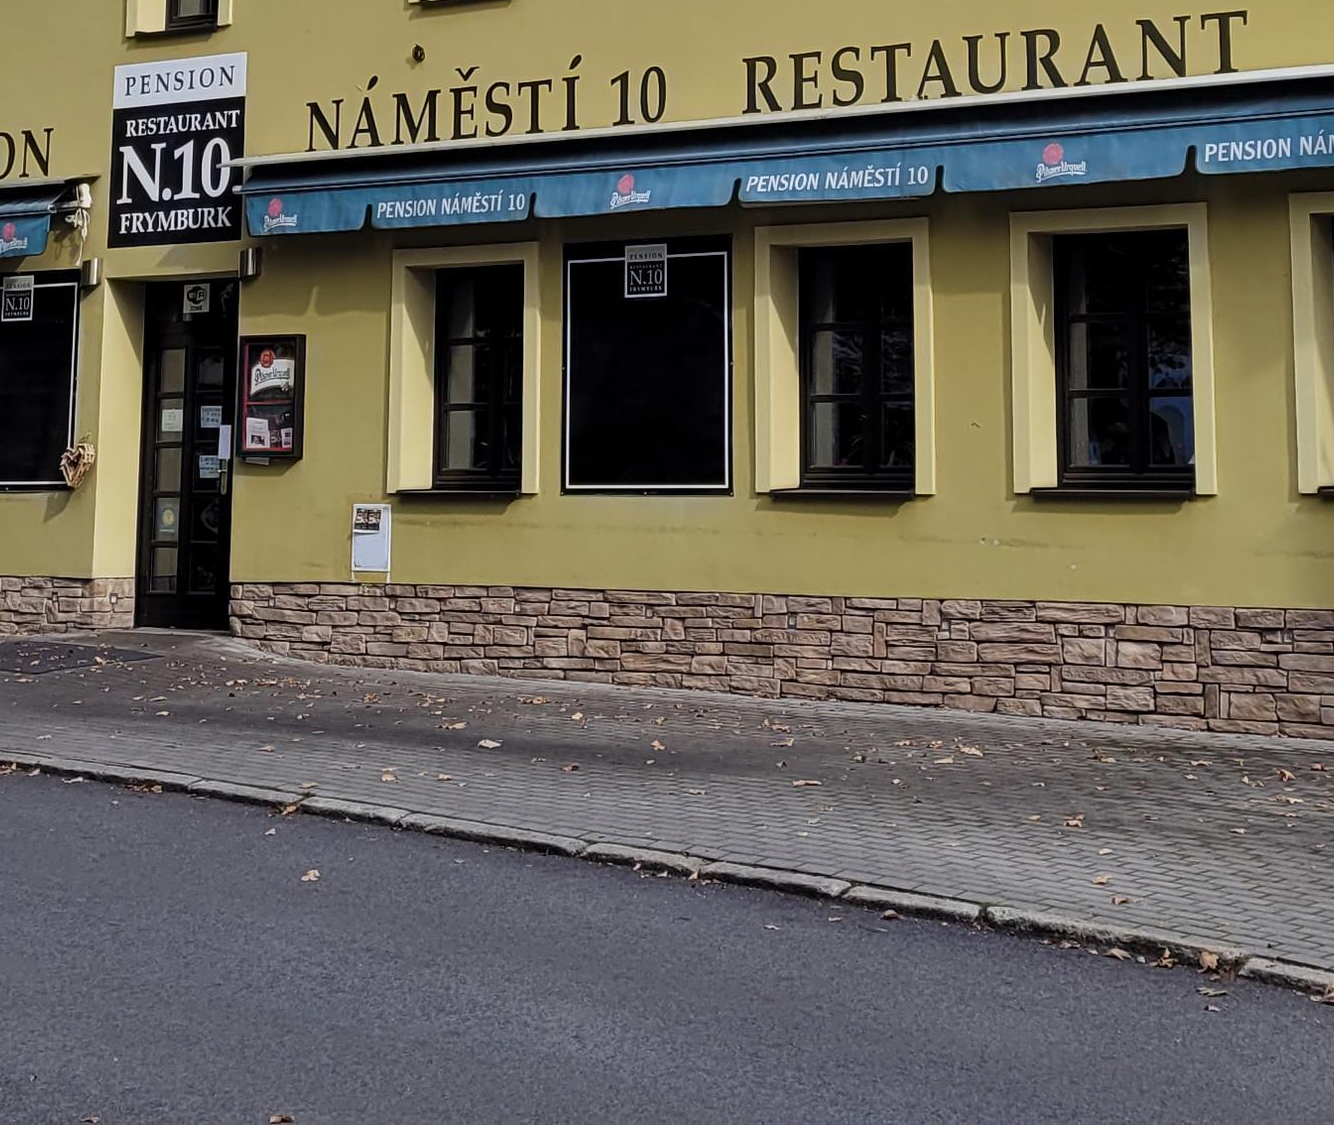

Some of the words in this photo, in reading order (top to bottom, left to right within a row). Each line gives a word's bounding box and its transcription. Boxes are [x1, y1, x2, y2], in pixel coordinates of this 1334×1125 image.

[742, 10, 1248, 114] RESTAURANT
[125, 66, 235, 96] PENSION
[305, 55, 582, 152] NÁMĚSTÍ
[611, 66, 667, 126] 10
[126, 110, 240, 137] RESTAURANT
[1205, 138, 1291, 163] PENSION
[117, 138, 230, 204] N.10
[746, 172, 818, 192] PENSION
[825, 163, 901, 189] NÁMĚSTÍ
[908, 166, 928, 185] 10
[377, 199, 435, 218] PENSION
[441, 189, 503, 215] NÁMĚSTÍ
[508, 194, 525, 211] 10
[119, 207, 232, 234] FRYMBURK
[630, 269, 663, 285] N.10
[6, 297, 30, 311] N.10
